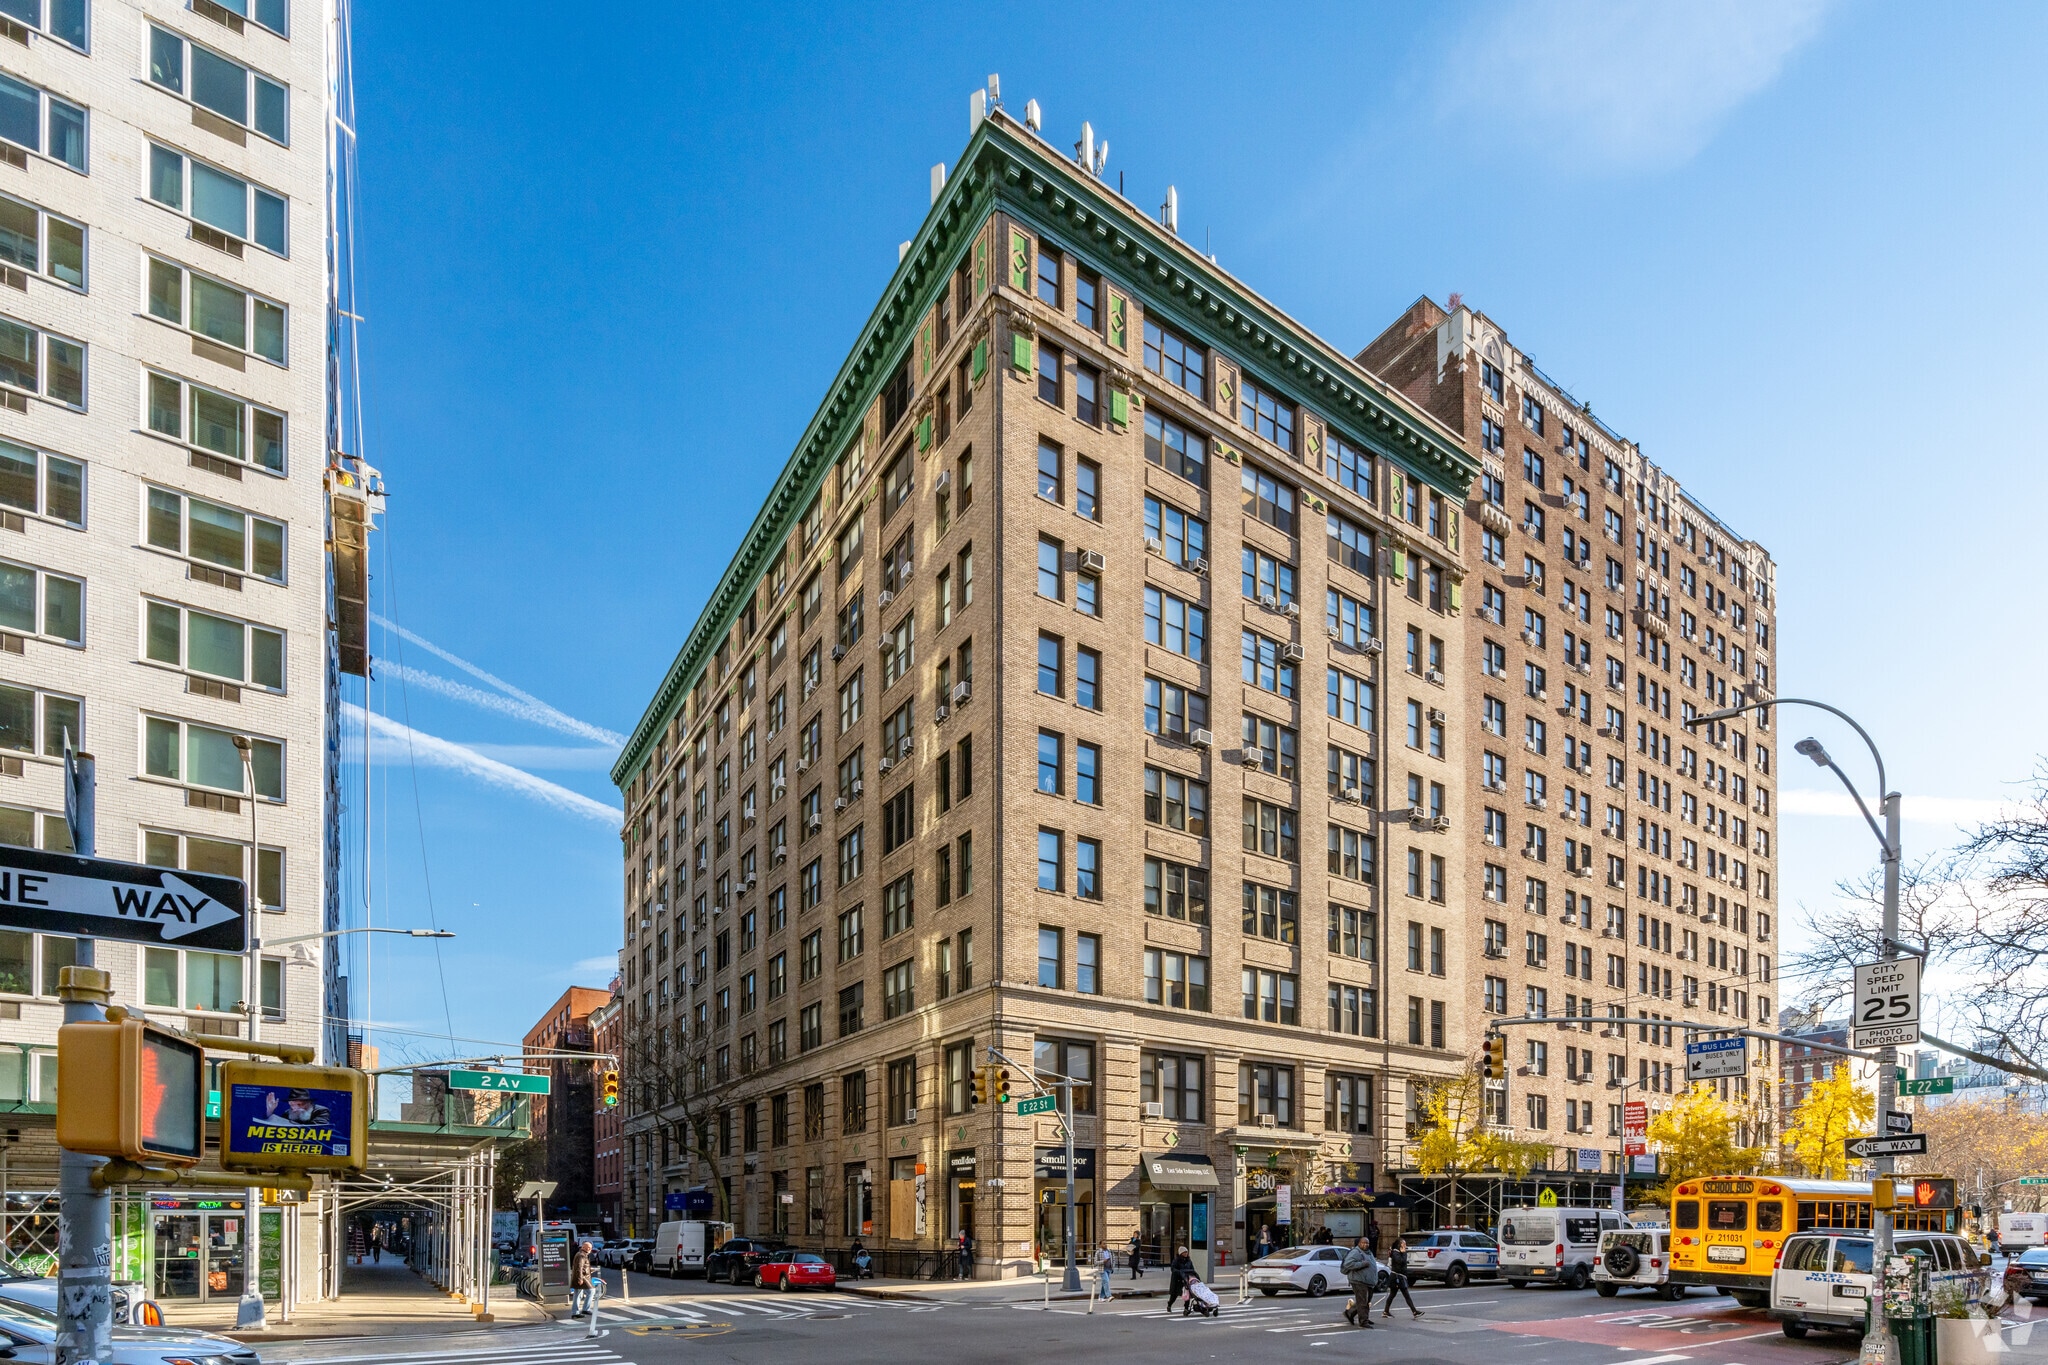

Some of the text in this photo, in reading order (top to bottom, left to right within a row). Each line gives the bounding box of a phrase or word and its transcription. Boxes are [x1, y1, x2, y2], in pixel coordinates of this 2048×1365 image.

[112, 886, 211, 924] WAY
[1873, 964, 1898, 974] CITY
[1867, 974, 1904, 985] SPEED
[1871, 984, 1901, 994] LIMIT
[1863, 994, 1911, 1021] 25
[1869, 1028, 1902, 1037] PHOTO
[1859, 1034, 1913, 1045] ENFORCED
[1705, 1051, 1723, 1059] BUSES
[481, 1075, 520, 1088] 2 Av
[1906, 1082, 1912, 1094] E
[1917, 1081, 1931, 1093] 22
[1023, 1100, 1048, 1112] E 22 St
[247, 1126, 332, 1141] MESSIAH
[264, 1143, 322, 1154] IS HERE!
[1857, 1141, 1915, 1152] ONE WAY
[1041, 1155, 1065, 1164] small
[1579, 1149, 1600, 1159] GEIGER
[1253, 1174, 1276, 1190] 380
[1704, 1182, 1752, 1193] SCHOOL BUS
[198, 1200, 222, 1208] ATM
[1718, 1234, 1743, 1242] 211031
[1805, 1276, 1853, 1284] POLICE
